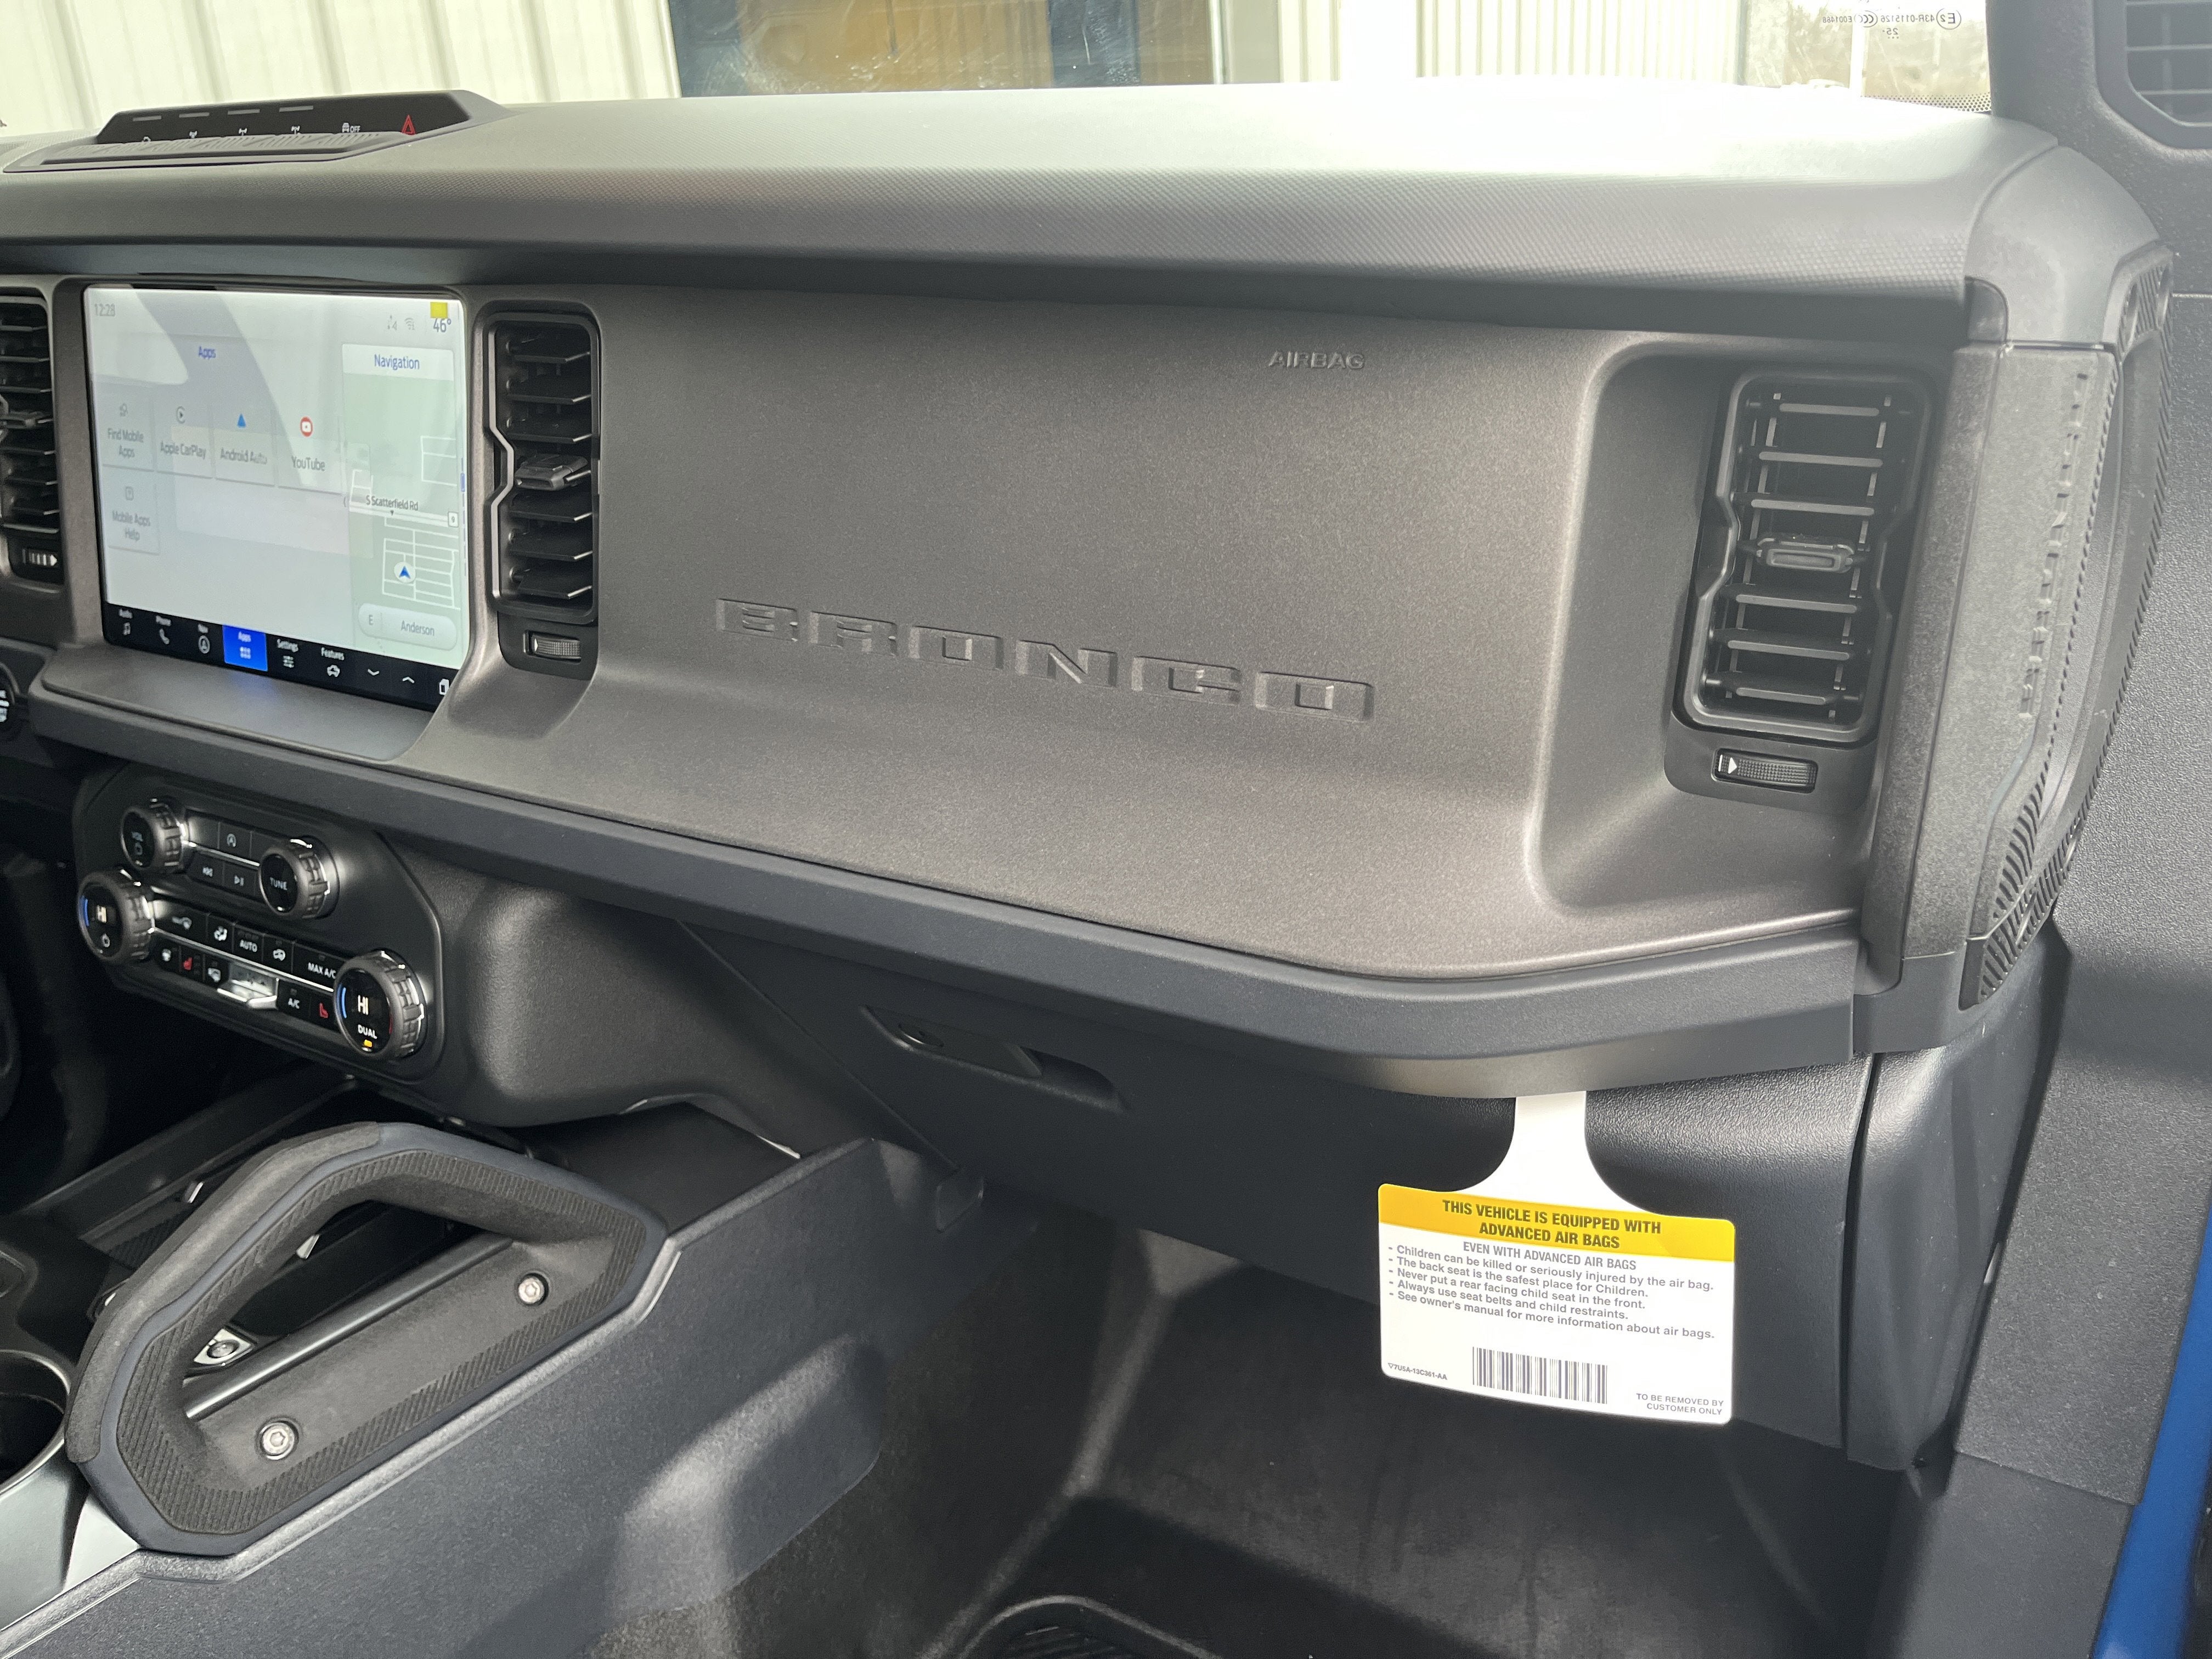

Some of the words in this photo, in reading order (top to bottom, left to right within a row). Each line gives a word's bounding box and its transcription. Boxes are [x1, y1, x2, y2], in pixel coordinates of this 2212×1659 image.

[198, 346, 217, 360] Apps
[1268, 351, 1364, 370] AIRBAG
[374, 354, 420, 370] Navigation
[108, 428, 121, 440] Find
[122, 430, 144, 443] Mobile
[119, 445, 135, 459] Apps
[160, 441, 179, 454] Apple
[180, 443, 206, 459] CarPlay
[221, 447, 249, 462] Android
[250, 452, 268, 465] Auto
[291, 455, 325, 471] YouTube
[366, 495, 371, 505] S
[371, 496, 409, 510] Scatterfield
[409, 501, 419, 511] Rd
[112, 510, 133, 524] Mobile
[134, 514, 150, 527] Apps
[369, 614, 374, 625] E
[401, 620, 435, 636] Anderson
[717, 598, 1374, 722] BRONCO
[270, 877, 287, 890] TUNE
[240, 939, 258, 952] AUTO
[308, 962, 324, 975] MAX
[324, 968, 336, 979] A/C
[287, 998, 300, 1009] A/C
[358, 995, 369, 1015] HI
[358, 1024, 377, 1039] DUAL
[1442, 1199, 1472, 1214] THIS
[1476, 1204, 1531, 1222] VEHICLE
[1535, 1211, 1547, 1224] IS
[1552, 1213, 1620, 1231] EQUIPPED
[1624, 1220, 1661, 1234] WITH
[1479, 1222, 1550, 1242] ADVANCED
[1555, 1232, 1578, 1245] AIR
[1583, 1234, 1620, 1249] BAGS
[1463, 1242, 1489, 1255] EVEN
[1493, 1245, 1520, 1259] WITH
[1524, 1250, 1581, 1265] ADVANCED
[1585, 1256, 1602, 1267] AIR
[1607, 1258, 1636, 1270] BAGS
[1397, 1245, 1441, 1260] Children
[1444, 1254, 1463, 1263] can
[1466, 1256, 1480, 1266] be
[1483, 1259, 1511, 1271] killed
[1515, 1263, 1527, 1272] or
[1530, 1266, 1582, 1280] seriously
[1585, 1271, 1626, 1283] injured
[1630, 1275, 1643, 1286] by
[1647, 1277, 1666, 1286] the
[1669, 1279, 1684, 1288] air
[1688, 1279, 1713, 1292] bag.
[1397, 1256, 1417, 1268] The
[1419, 1261, 1444, 1273] back
[1447, 1266, 1470, 1277] seat
[1473, 1269, 1482, 1278] is
[1485, 1271, 1503, 1281] the
[1505, 1274, 1539, 1286] safest
[1543, 1277, 1573, 1289] place
[1576, 1282, 1593, 1292] for
[1596, 1284, 1648, 1297] Children.
[1397, 1268, 1427, 1281] Never
[1430, 1274, 1447, 1285] put
[1460, 1280, 1481, 1290] rear
[1484, 1282, 1517, 1297] facing
[1521, 1286, 1548, 1299] child
[1552, 1292, 1575, 1302] seat
[1579, 1294, 1589, 1304] in
[1593, 1296, 1611, 1306] the
[1614, 1298, 1645, 1309] front.
[1398, 1279, 1435, 1295] Always
[1438, 1289, 1457, 1297] use
[1460, 1291, 1482, 1302] seat
[1486, 1294, 1512, 1306] belts
[1515, 1299, 1536, 1309] and
[1539, 1301, 1566, 1313] child
[1570, 1306, 1628, 1319] restraints.
[1398, 1291, 1417, 1302] See
[1420, 1296, 1461, 1310] owner's
[1464, 1304, 1503, 1316] manual
[1506, 1309, 1522, 1319] for
[1525, 1313, 1554, 1323] more
[1558, 1316, 1623, 1331] information
[1627, 1324, 1660, 1334] about
[1663, 1327, 1678, 1335] air
[1682, 1328, 1714, 1340] bags.
[1647, 1403, 1696, 1413] CUSTOMER
[1665, 1396, 1709, 1406] REMOVED
